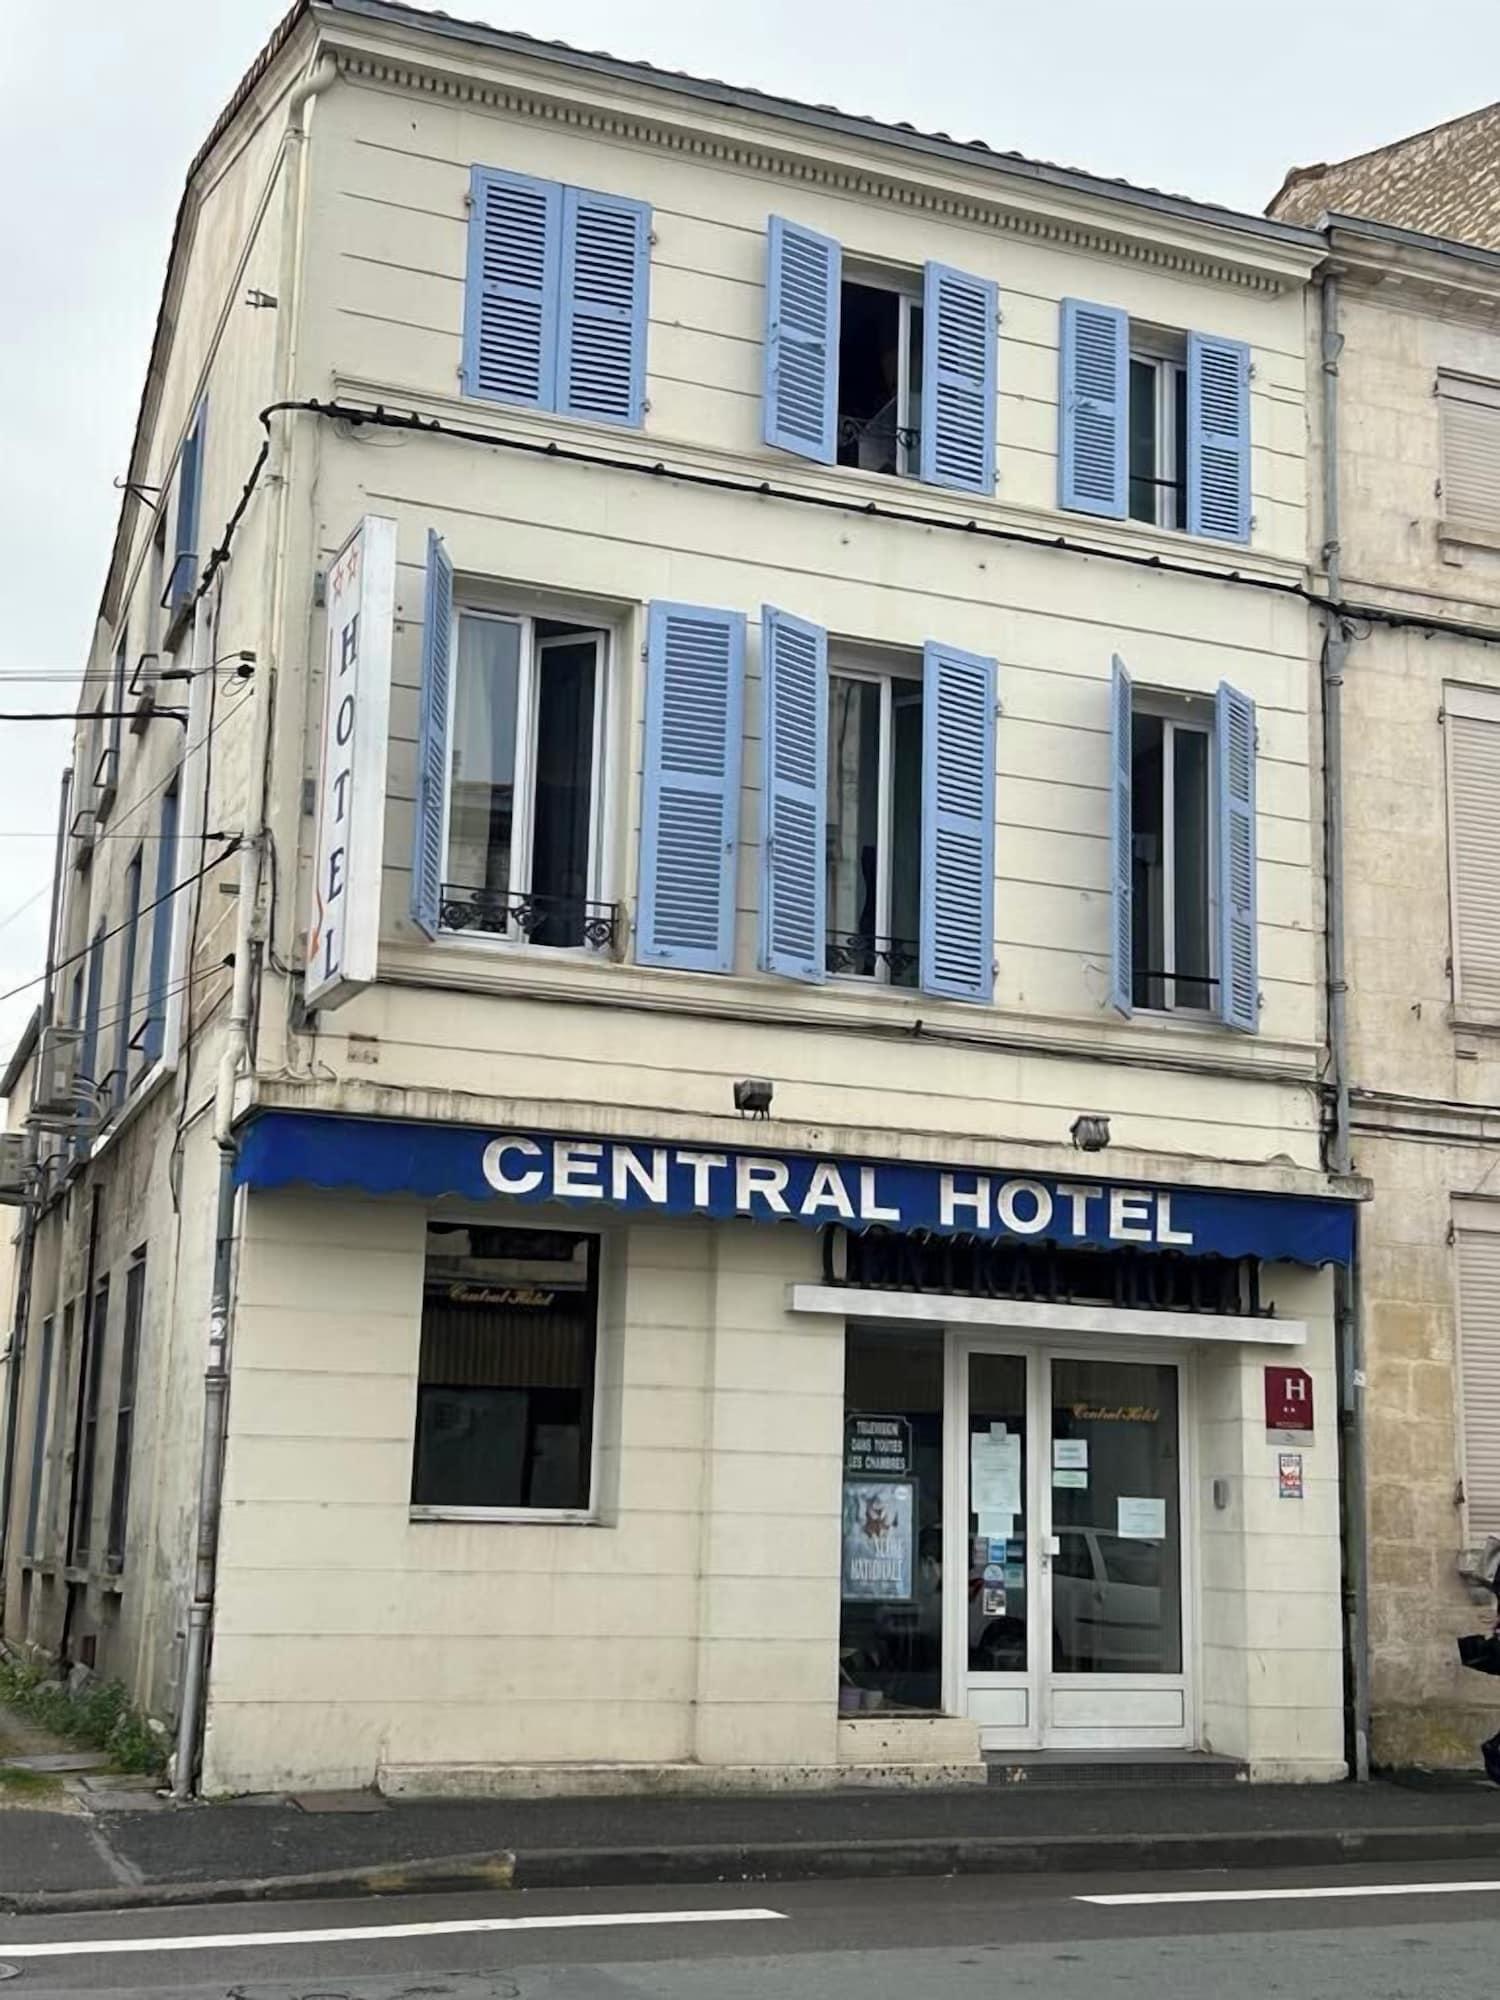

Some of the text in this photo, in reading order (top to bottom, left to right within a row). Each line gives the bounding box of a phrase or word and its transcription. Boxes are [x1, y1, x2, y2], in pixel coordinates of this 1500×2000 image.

[324, 613, 361, 980] HOTEL
[482, 1136, 1193, 1245] CENTRAL HOTEL
[1285, 1378, 1306, 1401] H
[851, 1438, 903, 1453] DANS TOUTES
[848, 1455, 906, 1470] LES CHAMBRES
